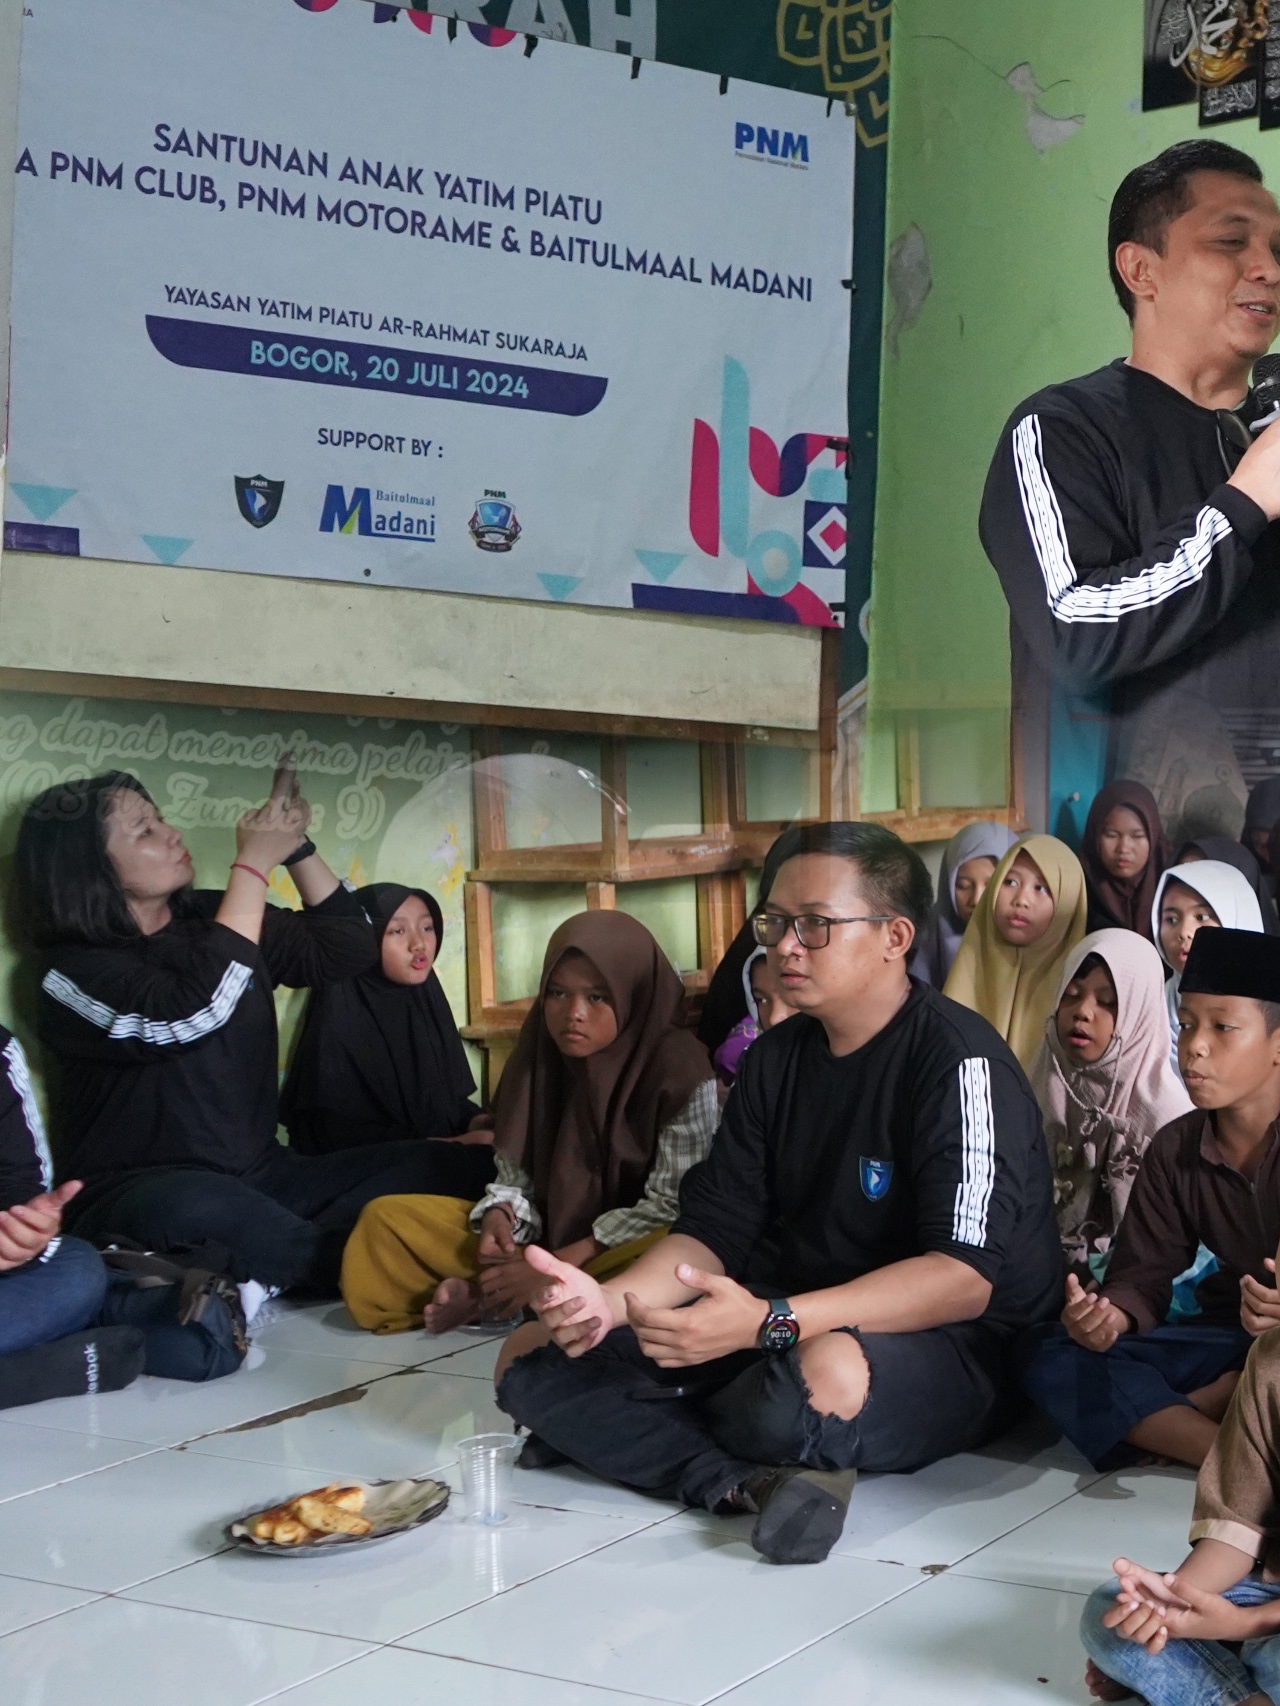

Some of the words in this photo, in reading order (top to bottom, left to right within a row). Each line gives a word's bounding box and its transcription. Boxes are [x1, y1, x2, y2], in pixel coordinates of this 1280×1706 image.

[734, 121, 810, 163] PNM
[153, 123, 329, 179] SANTUNAN
[337, 156, 425, 196] ANAK
[434, 171, 515, 212] YATIM
[524, 187, 603, 226] PIATU
[14, 146, 39, 178] A
[50, 150, 124, 191] PNM
[134, 165, 227, 213] CLUB,
[237, 181, 306, 219] PNM
[316, 194, 493, 250] MOTORAME
[500, 225, 521, 254] &
[530, 229, 703, 284] BAITULMAAL
[710, 261, 813, 303] MADANI
[164, 284, 251, 313] YAYASAN
[257, 297, 313, 323] YATIM
[318, 306, 373, 331] PIATU
[378, 315, 491, 348] AR-RAHMAT
[495, 331, 589, 362] SUKARAJA
[250, 340, 358, 380] BOGOR,
[366, 355, 400, 382] 20
[406, 361, 458, 389] JULI
[466, 368, 529, 399] 2024
[317, 427, 407, 454] SUPPORT
[411, 438, 433, 457] BY
[319, 484, 436, 536] Madani
[376, 489, 436, 507] Baitulmaal
